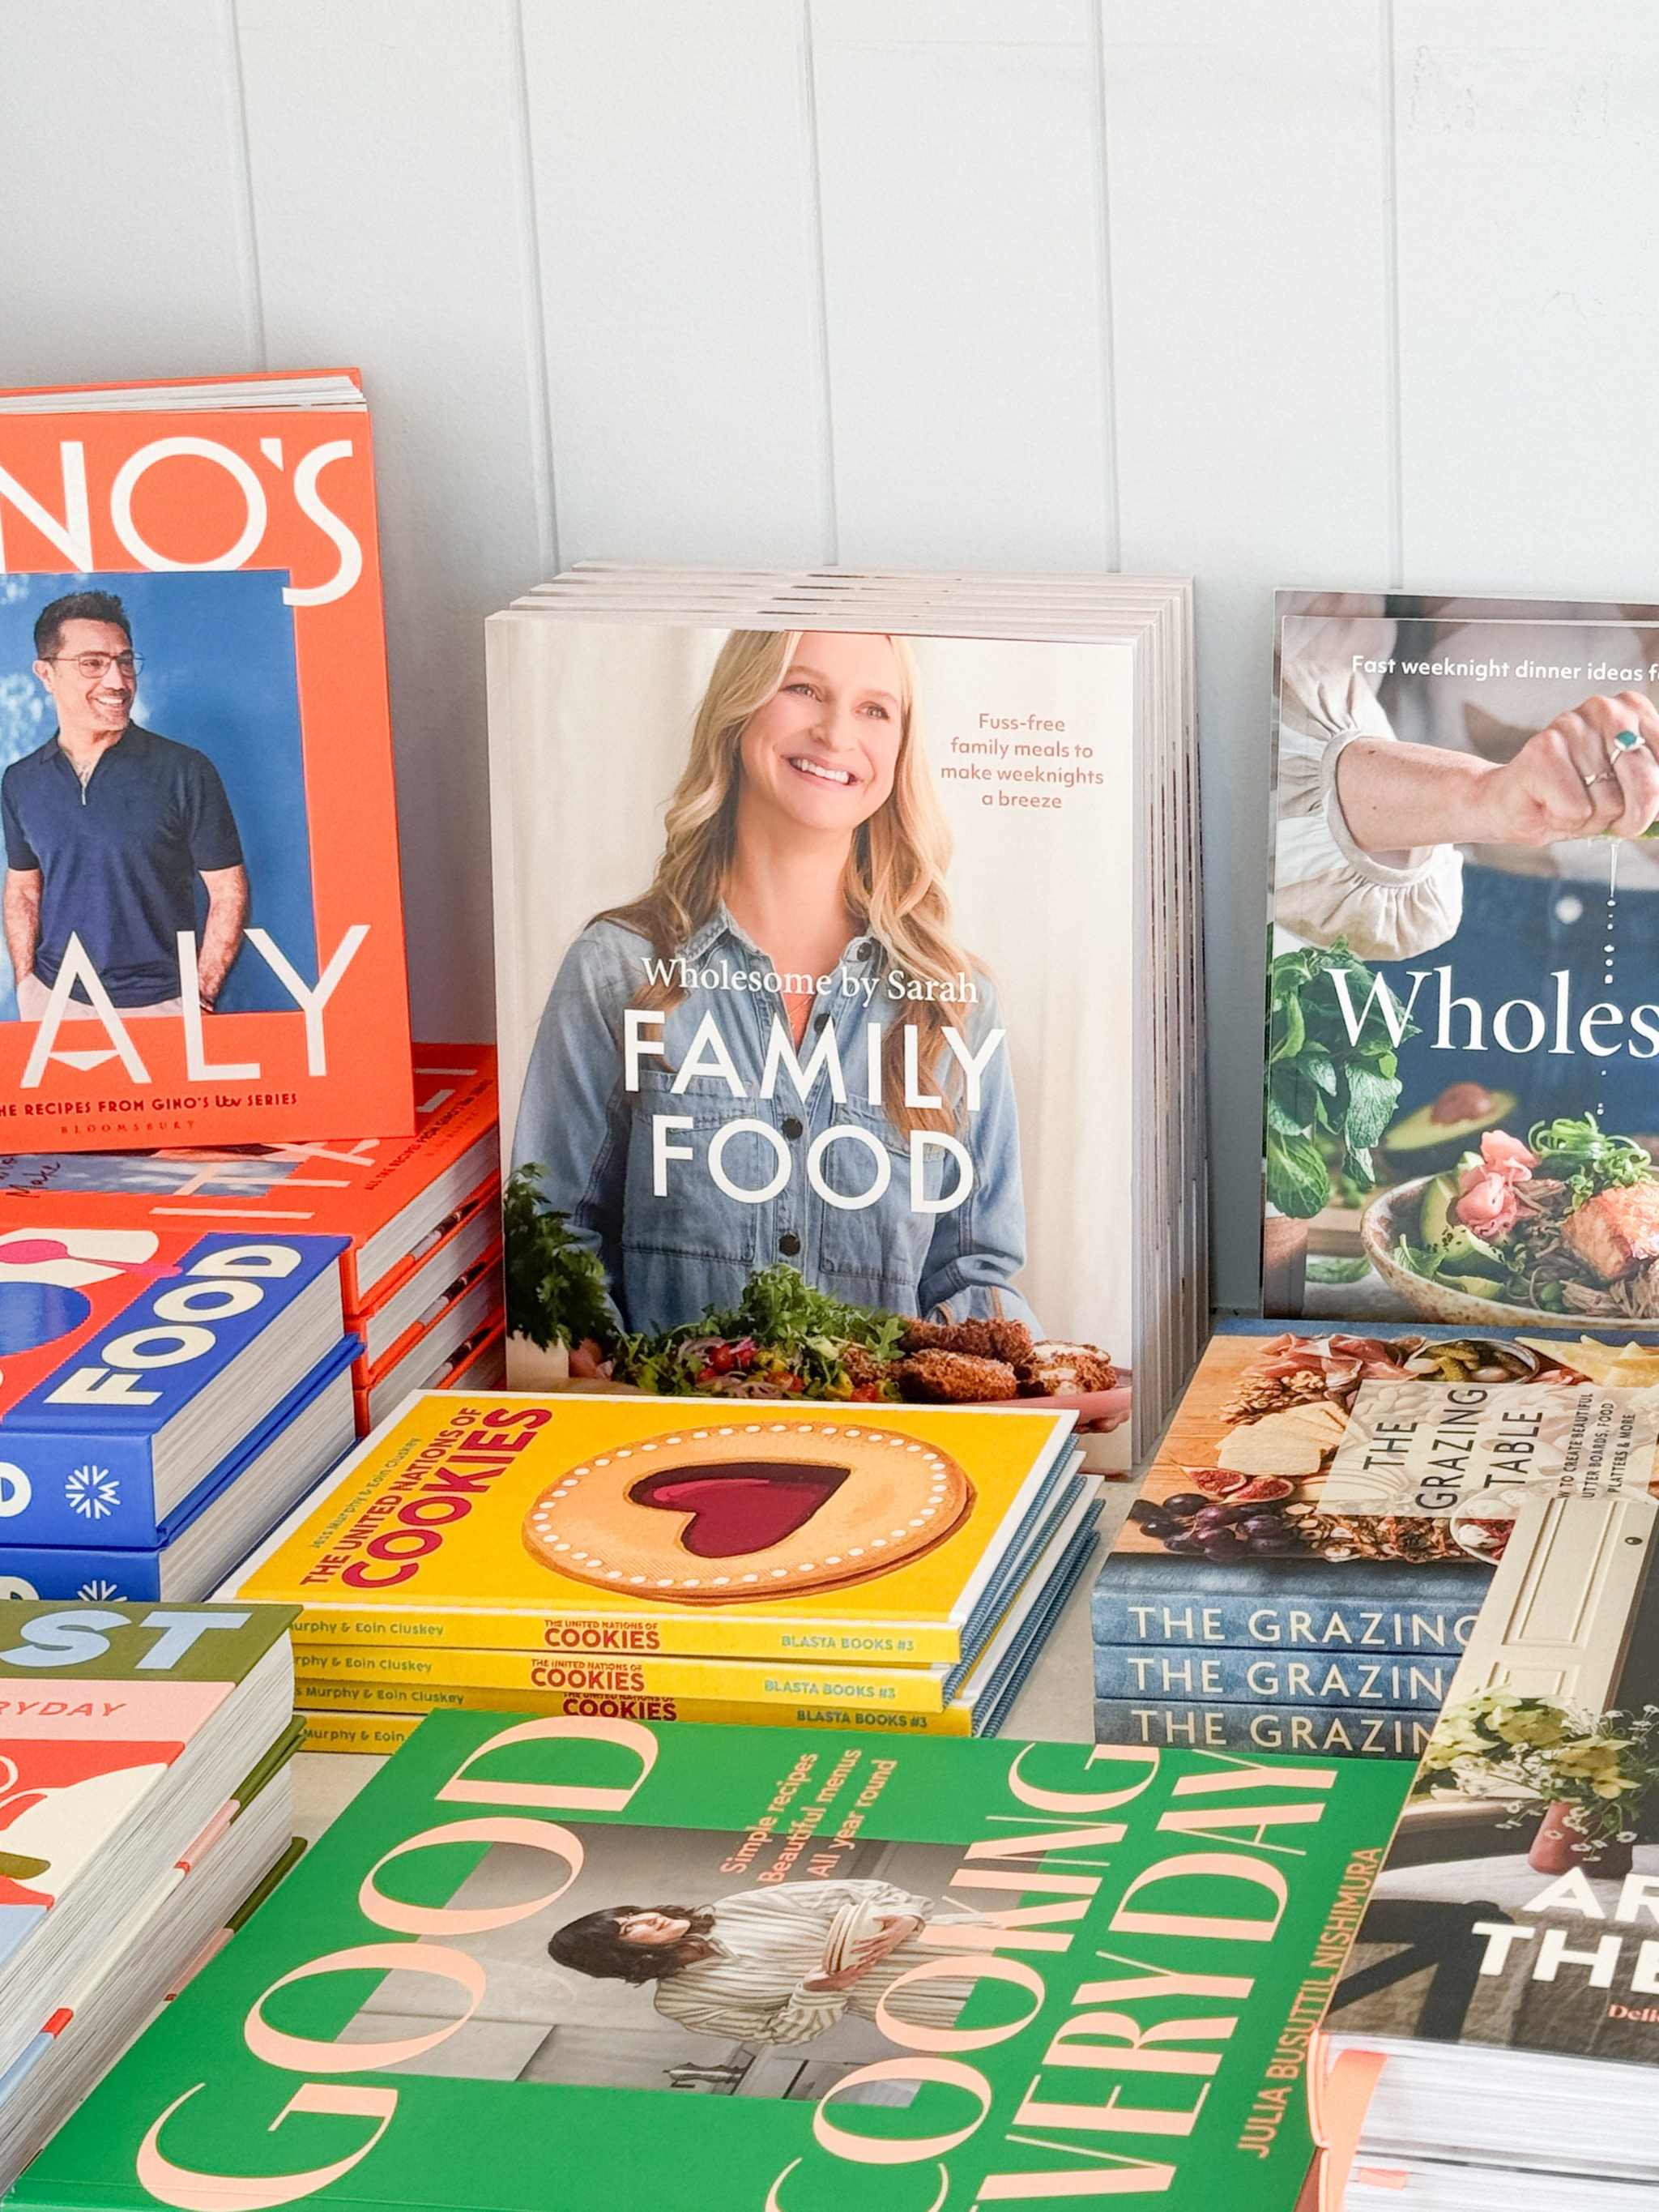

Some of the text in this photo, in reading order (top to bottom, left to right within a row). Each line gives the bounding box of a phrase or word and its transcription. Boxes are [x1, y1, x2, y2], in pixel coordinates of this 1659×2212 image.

[1352, 655, 1659, 681] Fast weeknight dinner ideas f
[979, 713, 1065, 732] Fuss-free
[951, 737, 1094, 759] family meals to
[940, 763, 1104, 788] make weeknights
[982, 789, 1063, 809] a breeze
[641, 957, 979, 1007] Wholesome by Sarah
[19, 925, 371, 1088] ALY
[1323, 964, 1659, 1058] Wholes
[623, 1009, 1007, 1112] FAMILY
[24, 1101, 92, 1116] RECIPES
[98, 1100, 144, 1113] FROM
[151, 1096, 209, 1111] GINO'S
[247, 1093, 297, 1107] SERIES
[61, 1121, 196, 1134] BLOOMSBURY
[651, 1115, 975, 1214] FOOD
[43, 1245, 301, 1405] FOOD
[1570, 1393, 1593, 1438] BEAUTIFUL
[1597, 1403, 1614, 1427] FOOD
[1363, 1422, 1418, 1471] THE
[1414, 1389, 1489, 1510] GRAZING
[1483, 1411, 1543, 1488] TABLE
[1563, 1441, 1583, 1472] CREATE
[1588, 1429, 1610, 1467] BOARDS,
[1607, 1451, 1628, 1492] PLATTERS
[1618, 1413, 1636, 1439] MORE
[300, 1407, 482, 1586] THE UNITED NATIONS OF
[342, 1407, 552, 1588] COOKIES
[1559, 1475, 1575, 1488] TO
[341, 1622, 351, 1632] &
[356, 1622, 386, 1633] Eoin
[390, 1623, 444, 1635] Cluskey
[544, 1619, 658, 1630] THE UNITED NATIONS OF
[544, 1628, 661, 1650] COOKIES
[1128, 1607, 1226, 1640] THE
[781, 1635, 915, 1651] BLASTA BOOKS #3
[331, 1658, 341, 1667] &
[345, 1659, 375, 1669] Eoin
[380, 1659, 432, 1672] Cluskey
[531, 1659, 642, 1672] THE UNITED NATIONS OF
[531, 1668, 645, 1692] COOKIES
[1128, 1658, 1223, 1693] THE
[305, 1686, 359, 1700] Murphy
[364, 1689, 373, 1698] &
[377, 1689, 407, 1701] Eoin
[412, 1691, 464, 1705] Cluskey
[764, 1680, 895, 1699] BLASTA BOOKS #3
[563, 1698, 677, 1721] COOKIES
[797, 1710, 928, 1727] BLASTA BOOKS #3
[304, 1729, 404, 1742] Murphy & Eoin
[1132, 1710, 1226, 1745] THE
[720, 1753, 819, 1874] Simple recipes
[757, 1749, 863, 1883] Beautiful menus
[807, 1759, 898, 1877] All year round
[136, 1715, 659, 2212] GOOD
[970, 1749, 1338, 2212] VERYDAY
[1237, 1847, 1384, 2159] JULIA BUSUTTIL NISHIMURA
[1607, 2003, 1659, 2024] Deli
